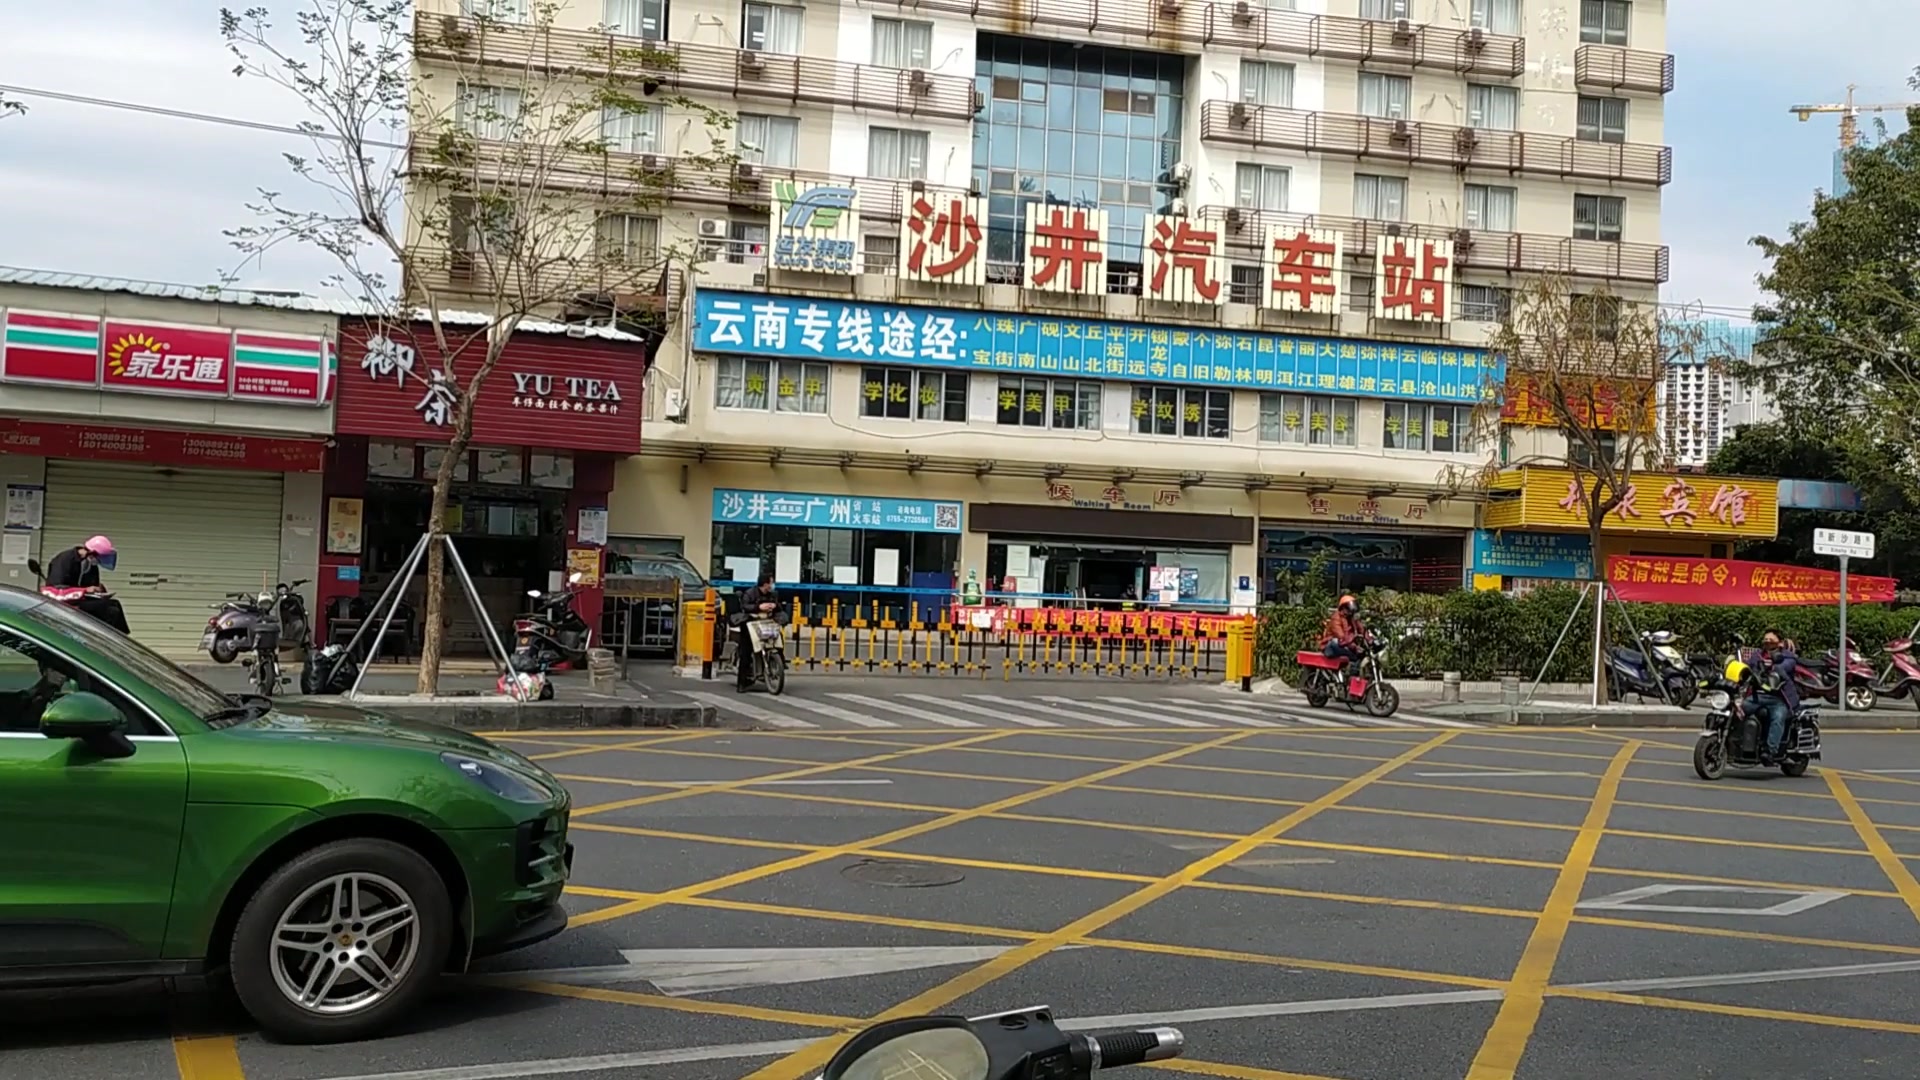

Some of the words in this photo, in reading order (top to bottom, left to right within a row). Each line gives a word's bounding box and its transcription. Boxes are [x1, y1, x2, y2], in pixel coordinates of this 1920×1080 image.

[906, 199, 1448, 318] 沙井汽车站
[122, 350, 226, 384] 家乐通
[512, 372, 553, 396] YU
[565, 376, 622, 401] TEA
[1047, 482, 1181, 506] 候车厅
[1074, 500, 1111, 510] Waiting
[1123, 502, 1151, 510] Room
[721, 492, 771, 521] 沙井
[803, 497, 851, 525] 广州
[852, 513, 882, 526] 火车站
[1307, 497, 1428, 520] 售票厅
[1337, 514, 1365, 522] Ticket
[1372, 514, 1399, 524] Office
